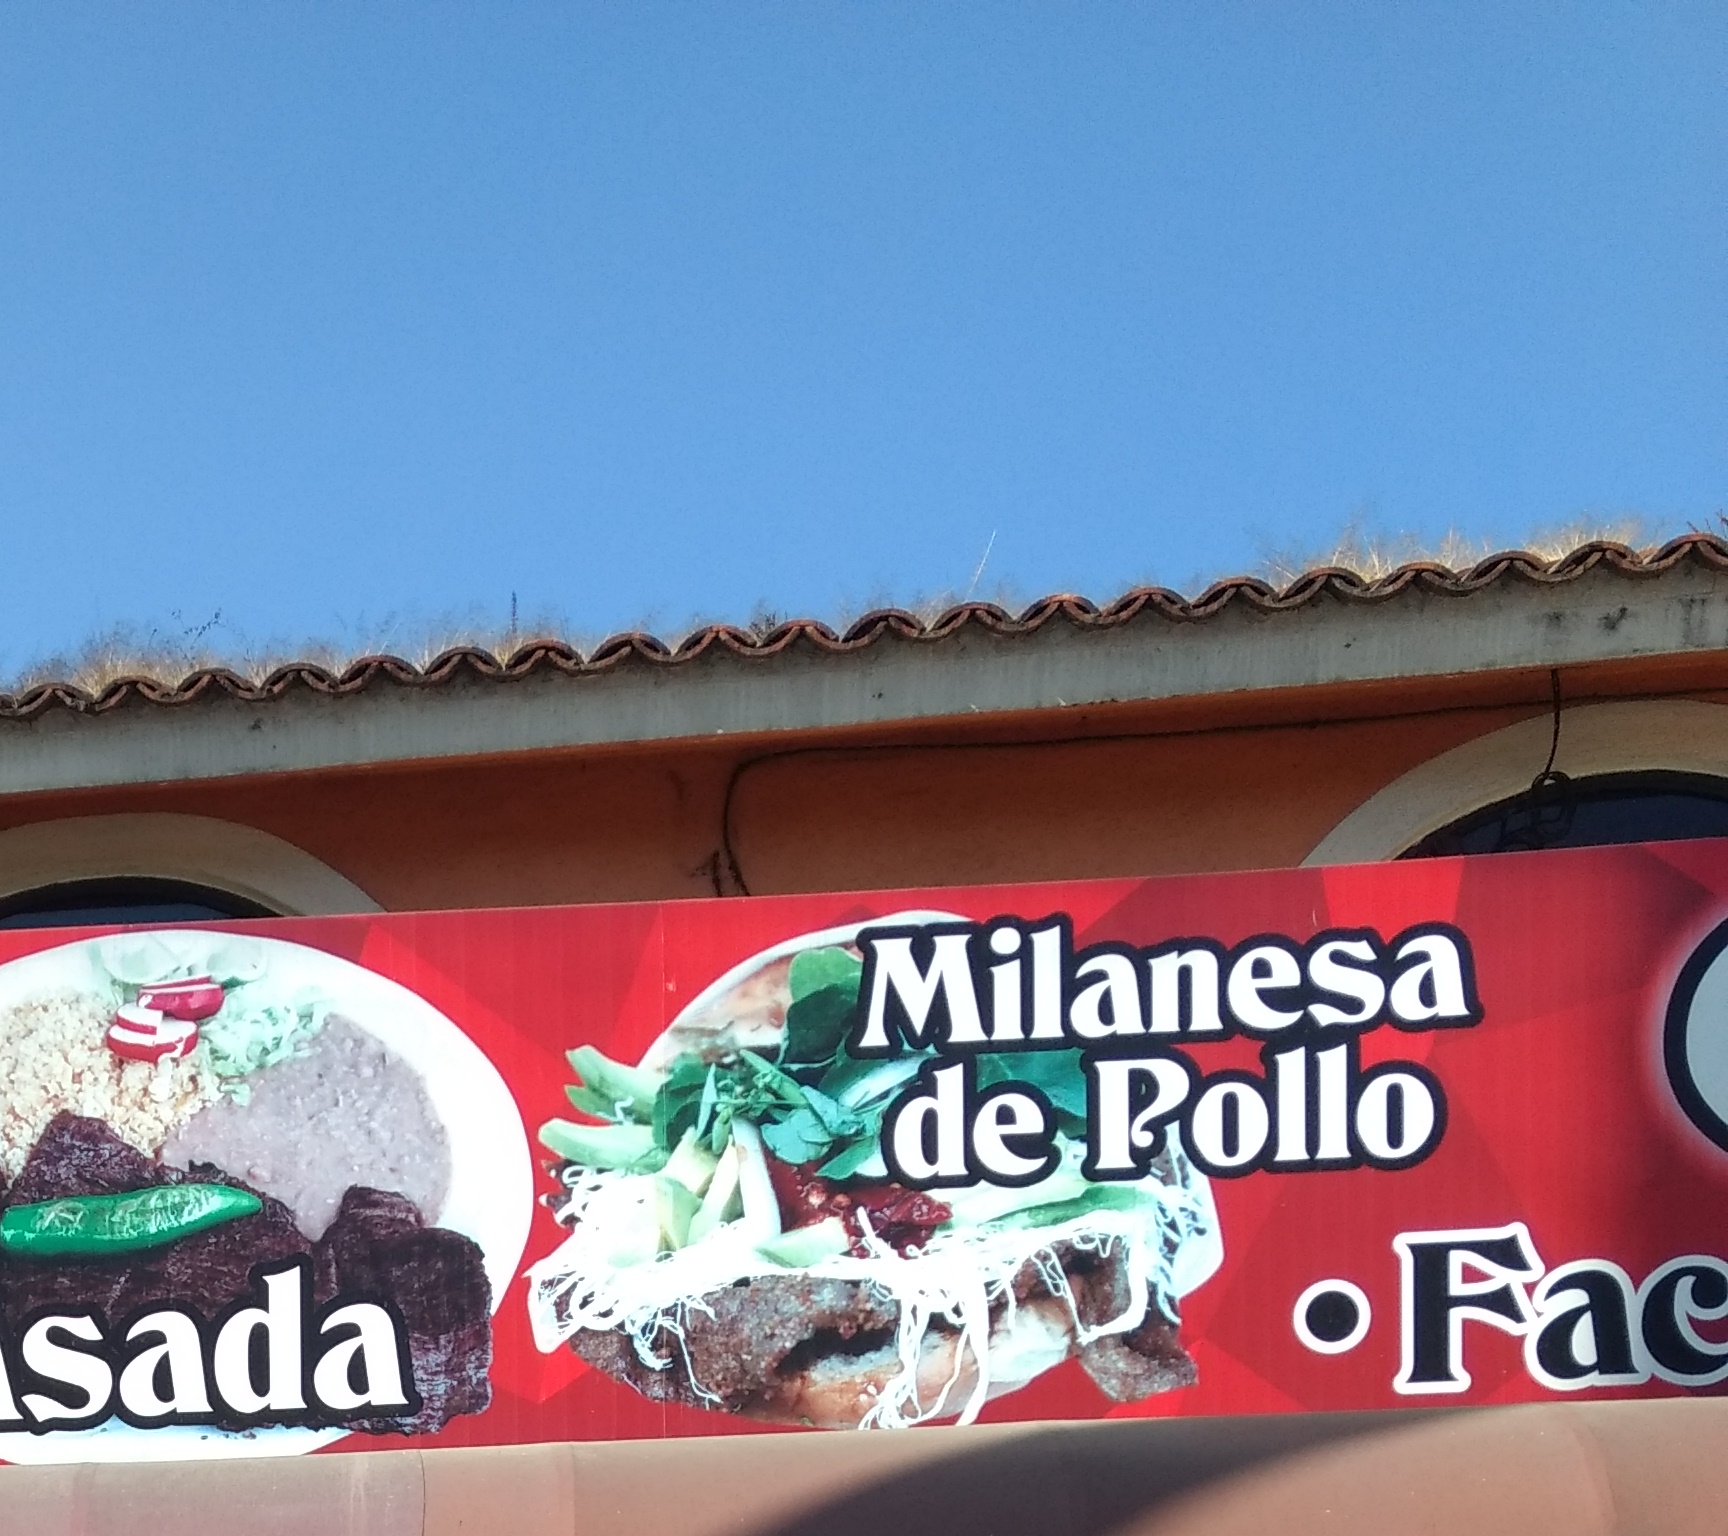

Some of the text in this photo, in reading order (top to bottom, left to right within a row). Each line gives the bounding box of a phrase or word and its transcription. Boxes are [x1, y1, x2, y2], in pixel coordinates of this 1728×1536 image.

[856, 918, 1477, 1047] Milanesa
[886, 1042, 1442, 1183] de Pollo
